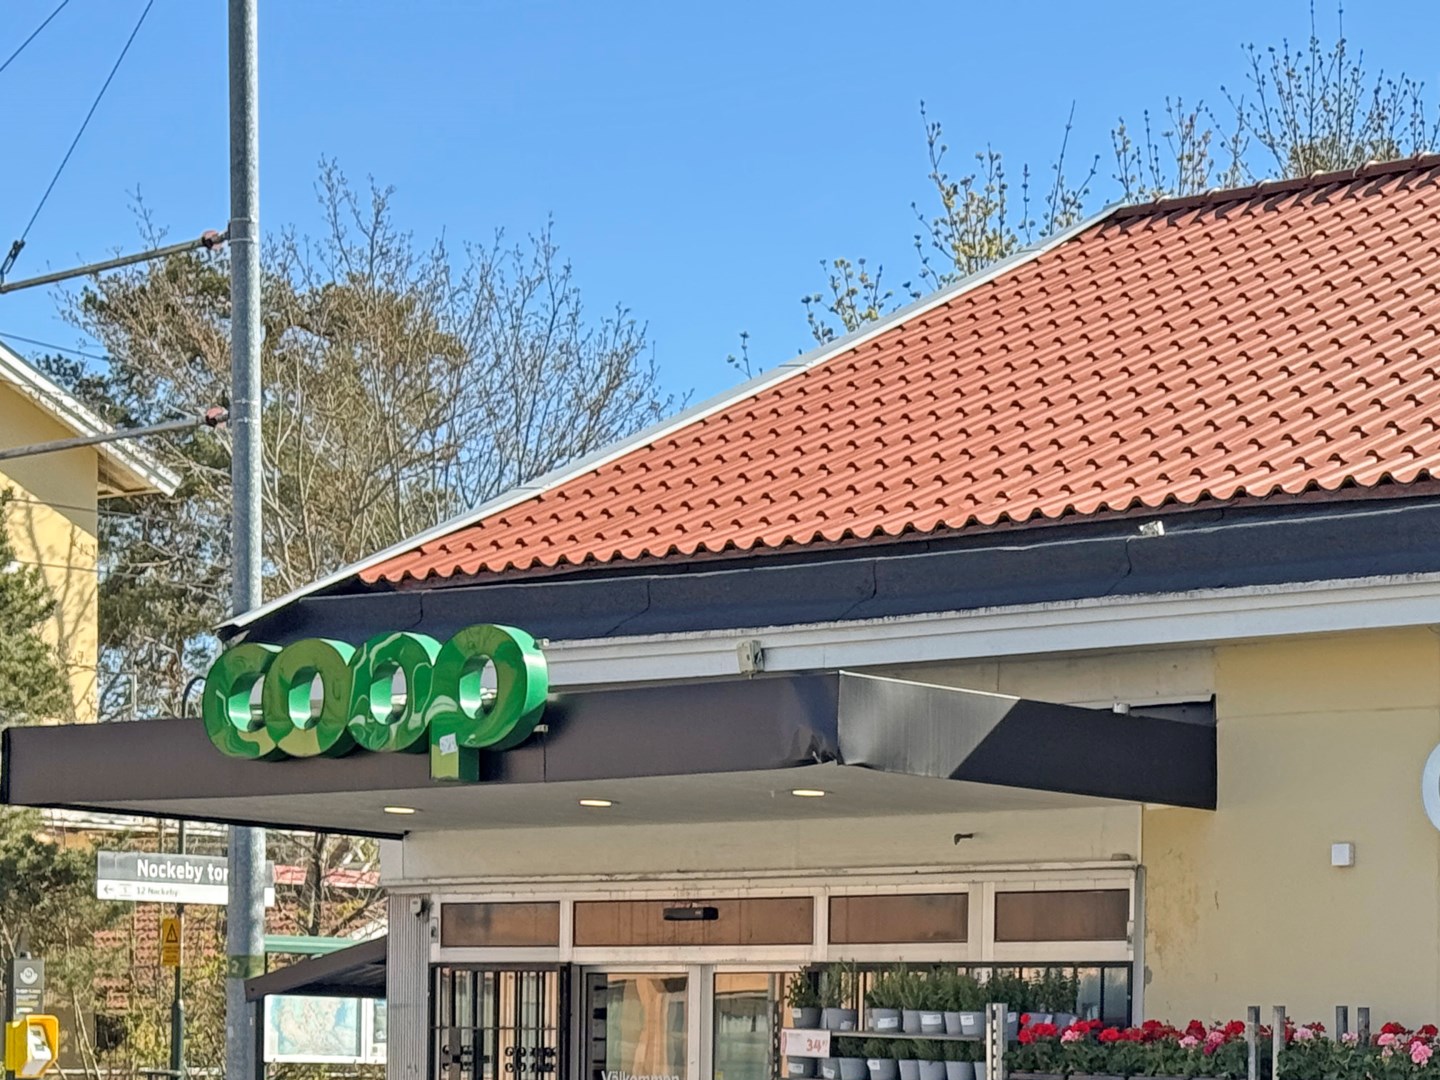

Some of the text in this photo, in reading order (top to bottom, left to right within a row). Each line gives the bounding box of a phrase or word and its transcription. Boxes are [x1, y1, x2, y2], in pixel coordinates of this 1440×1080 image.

[203, 622, 549, 782] coop
[137, 859, 229, 883] Nockeby tor
